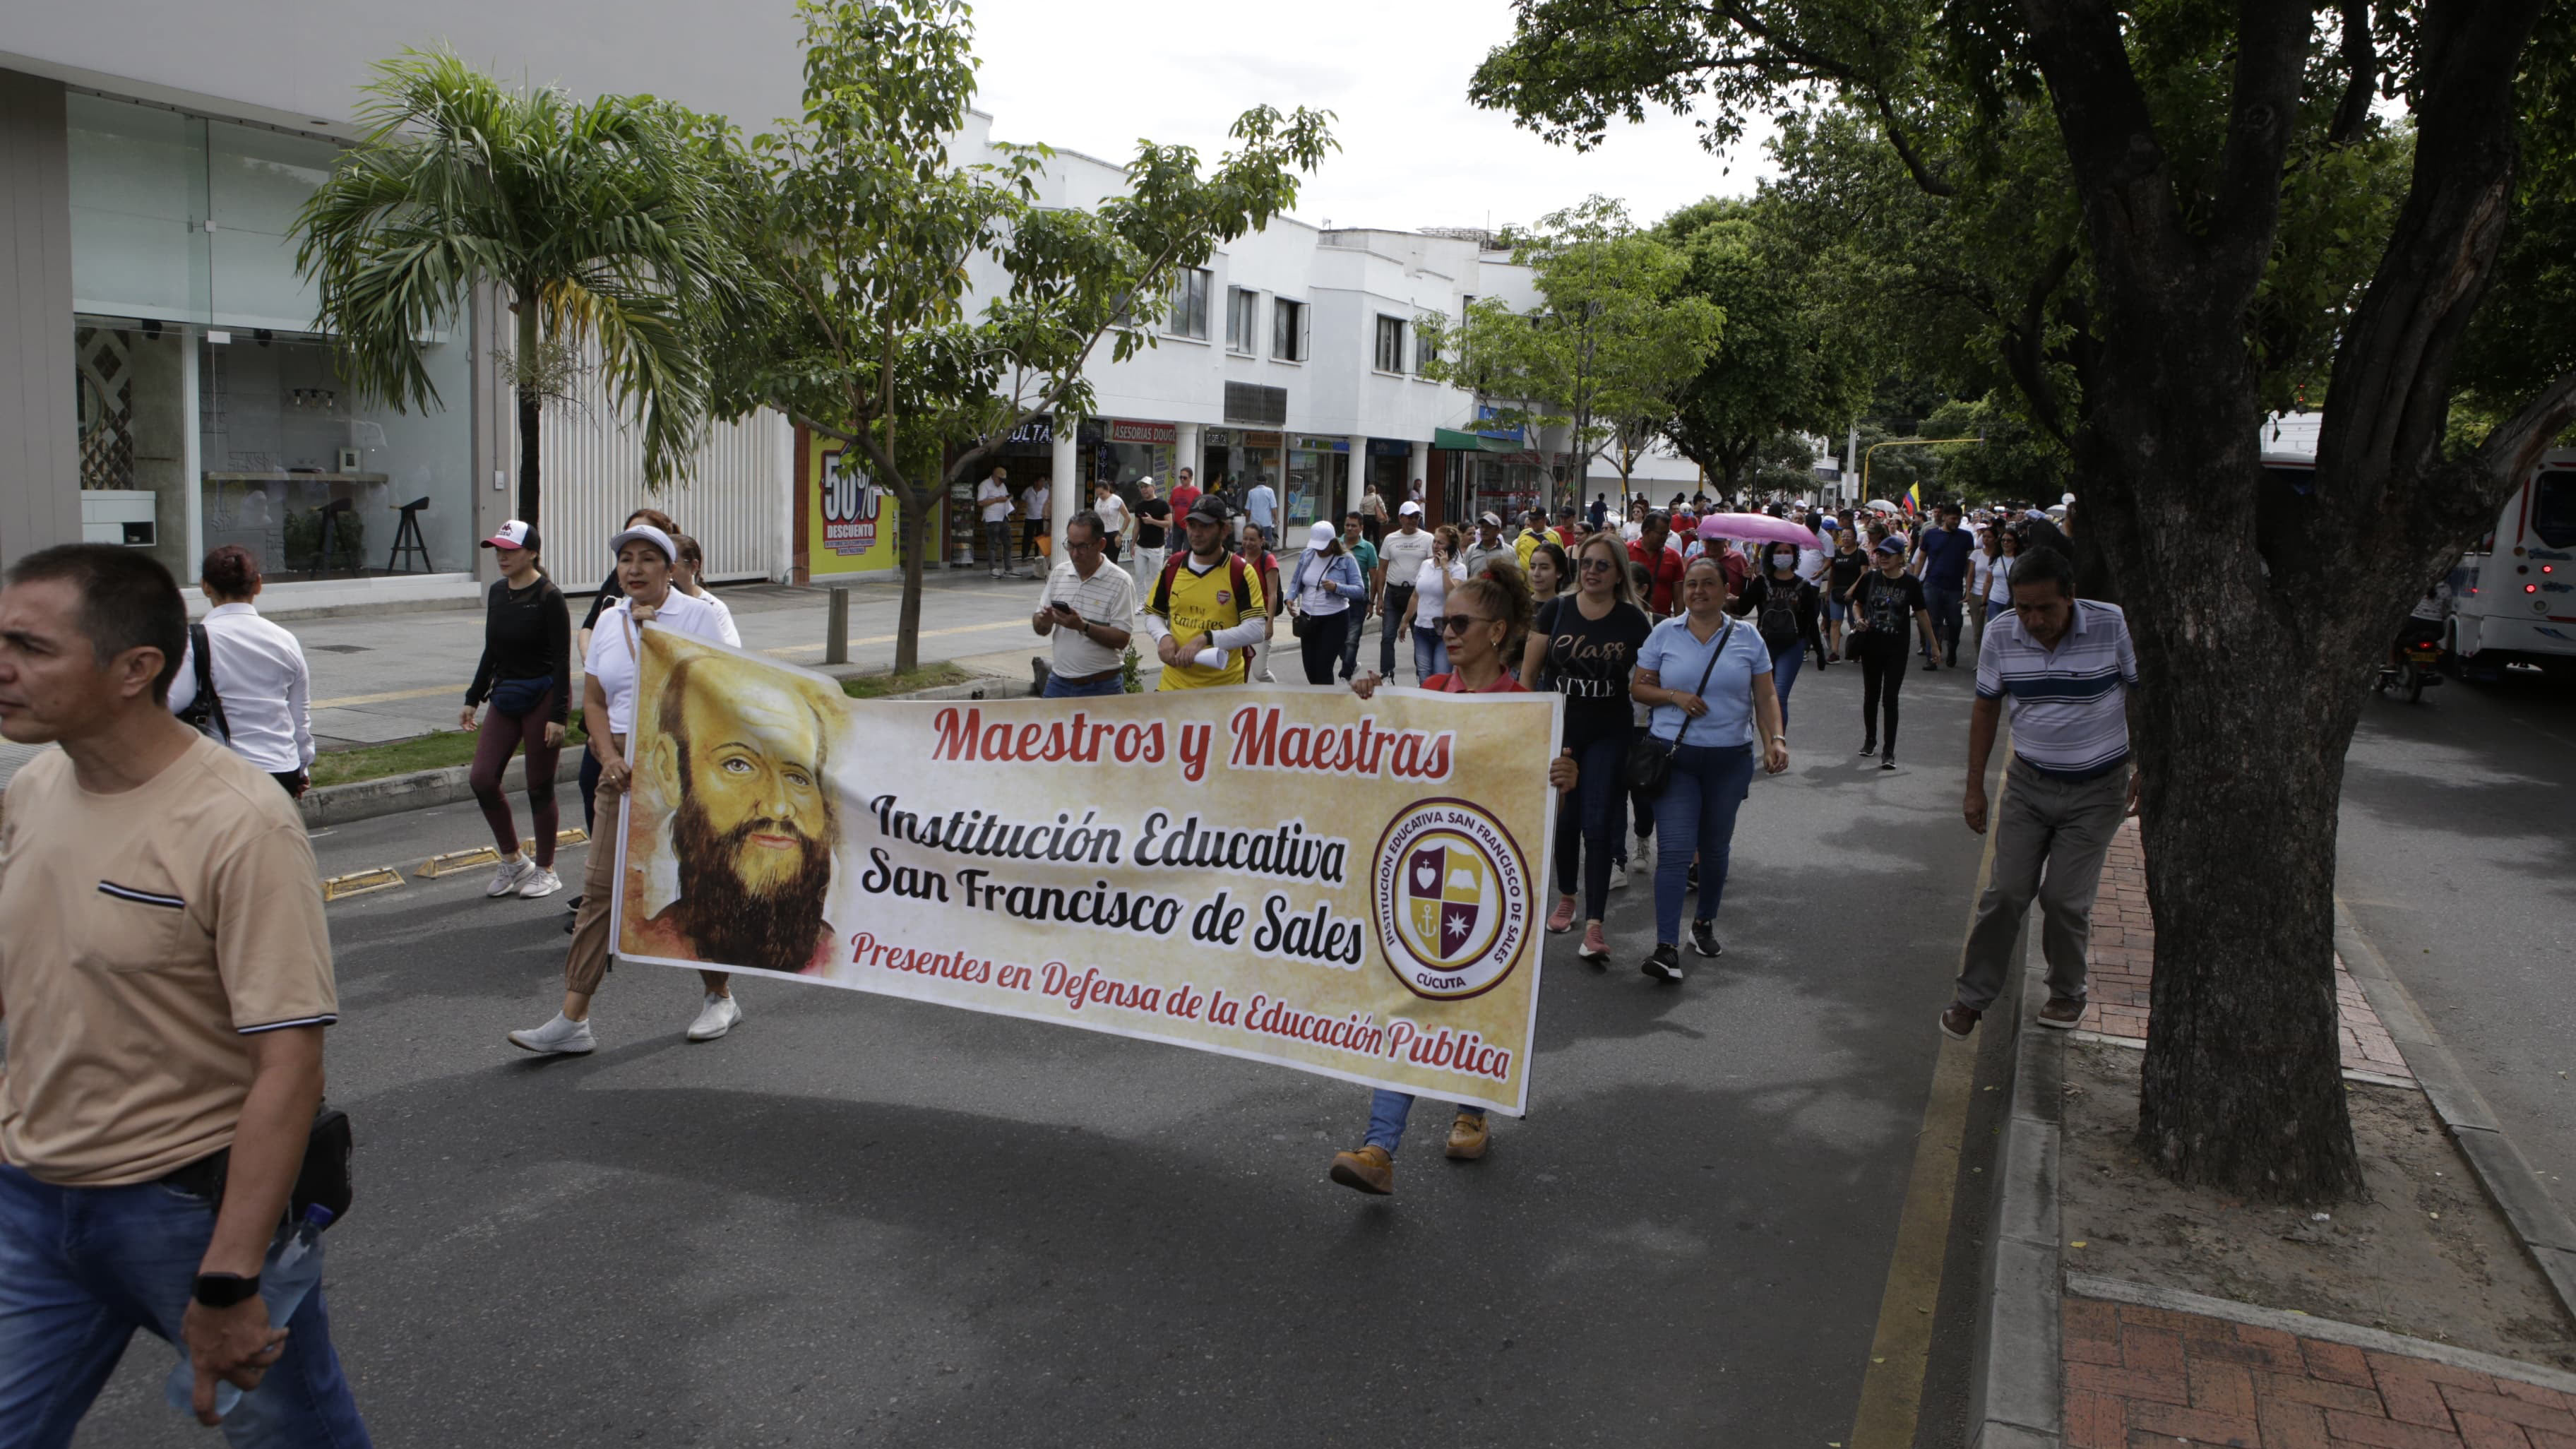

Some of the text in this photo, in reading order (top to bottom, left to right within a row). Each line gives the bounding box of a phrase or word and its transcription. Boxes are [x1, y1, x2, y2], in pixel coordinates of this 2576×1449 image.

[1153, 428, 1175, 441] DOUGL
[827, 523, 873, 538] DESCUENTO
[1174, 613, 1224, 631] Emirates
[1552, 635, 1626, 661] Class
[1554, 675, 1615, 697] STYLE
[931, 707, 1452, 782] Maestros y Maestras
[871, 794, 1346, 883] Institución Educativa
[1378, 811, 1522, 965] INSTITUCIÓN EDUCATIVA SAN FRANCISCO DE SALES
[861, 847, 1361, 965] San Francisco de Sales
[1417, 971, 1467, 989] CÚCUTA
[851, 932, 991, 984] Presentes
[997, 965, 1032, 991] en
[1042, 962, 1161, 1012] Defensa
[1166, 985, 1203, 1019] de
[1208, 991, 1239, 1026] la
[1244, 995, 1383, 1055] Educación
